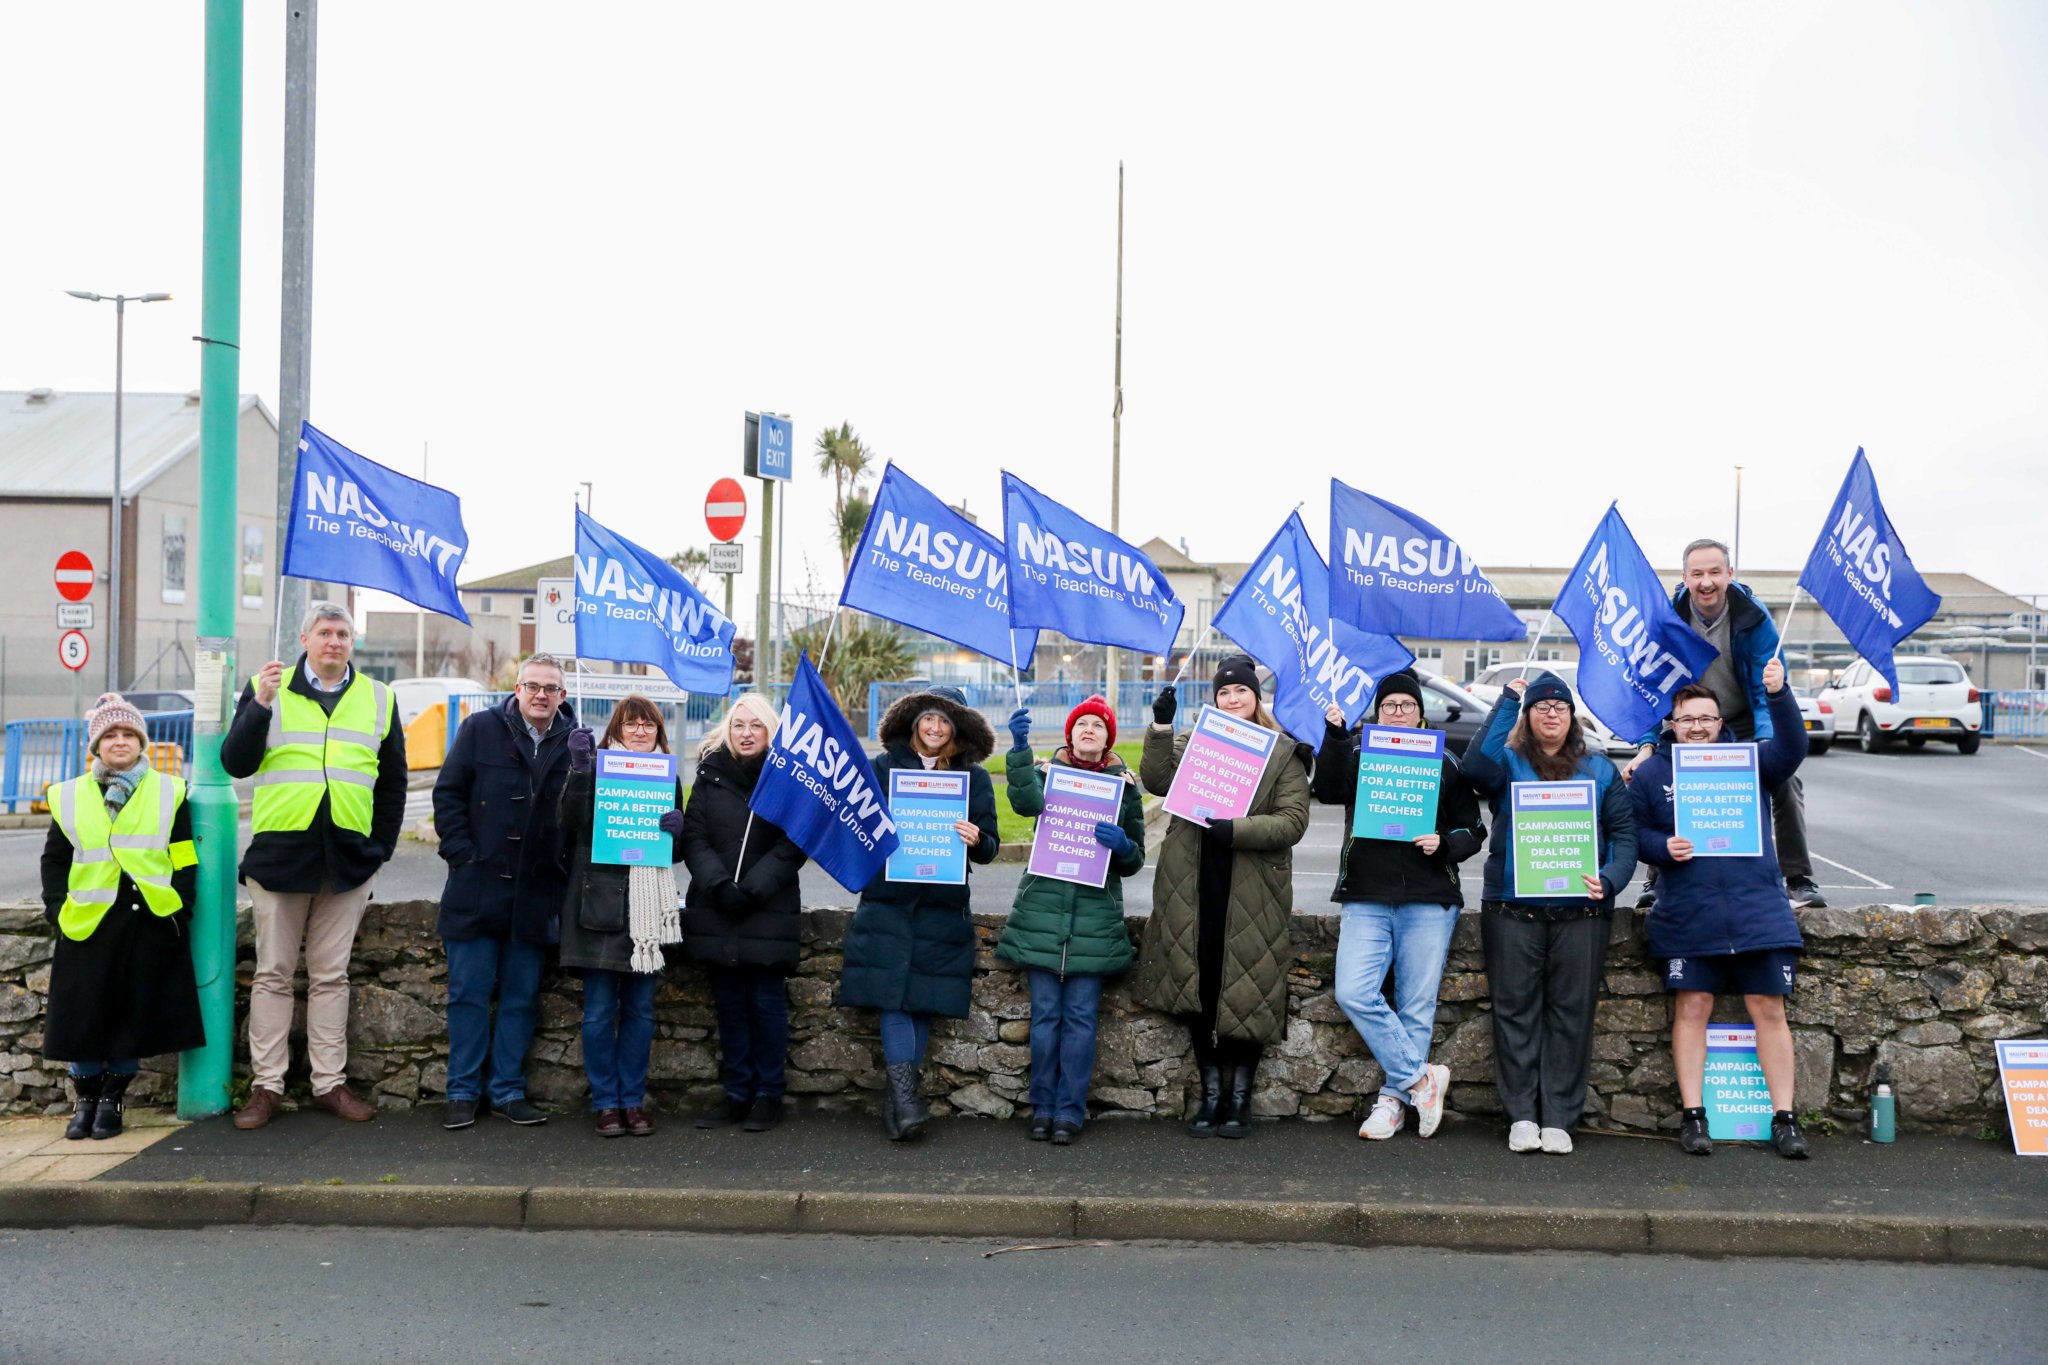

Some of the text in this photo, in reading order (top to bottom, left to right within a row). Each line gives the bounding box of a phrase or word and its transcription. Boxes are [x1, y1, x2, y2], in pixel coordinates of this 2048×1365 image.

[768, 428, 784, 446] NO
[766, 449, 786, 468] EXIT
[306, 514, 340, 534] The
[307, 471, 462, 578] NASWT
[713, 548, 739, 558] Except
[874, 510, 1008, 596] NASUW
[1344, 527, 1482, 578] NASUW
[1826, 536, 1842, 567] The
[714, 559, 737, 569] buses
[1018, 522, 1172, 606] NASUW
[871, 550, 981, 600] The Teachers'
[1344, 567, 1374, 586] The
[1379, 572, 1460, 593] Teachers'
[1021, 564, 1047, 585] The
[1053, 573, 1126, 601] Teachers'
[1588, 541, 1692, 694] NSUWT
[575, 598, 597, 614] he
[673, 636, 722, 657] Union
[1257, 553, 1374, 706] NASUWT
[1584, 574, 1599, 604] The
[1623, 668, 1660, 707] Union
[69, 642, 78, 658] 5
[1251, 585, 1277, 616] The
[1309, 686, 1332, 712] Uni
[583, 682, 607, 690] PLEASE
[644, 685, 681, 693] RECEPTION
[1192, 744, 1259, 775] CAMPAIGNING
[772, 703, 896, 841] NASUWT
[1188, 756, 1208, 769] FOR
[1218, 768, 1252, 787] BETTER
[1360, 762, 1439, 777] CAMPAIGNING
[1193, 772, 1238, 795] DEAL FOR
[1361, 776, 1435, 790] FOR A BETTER
[1679, 782, 1753, 791] CAMPAIGNING
[597, 787, 673, 800] CAMPAIGNING
[767, 748, 786, 769] he
[840, 806, 875, 852] Union
[1187, 783, 1234, 808] TEACHERS
[1370, 790, 1423, 802] DEAL FOR
[1681, 795, 1703, 804] FOR
[1714, 795, 1752, 804] BETTER
[598, 801, 670, 814] FOR A BETTER
[894, 808, 964, 819] CAMPAIGNING
[1045, 804, 1113, 823] CAMPAIGNING
[1368, 804, 1423, 816] TEACHERS
[1692, 808, 1742, 816] DEAL FOR
[608, 816, 659, 827] DEAL FOR
[895, 821, 956, 831] FOR A BETTE
[1044, 816, 1096, 833] FOR A BETT
[1518, 821, 1591, 830] CAMPAIGNING
[1690, 821, 1744, 829] TEACHERS
[606, 829, 660, 840] TEACHERS
[904, 834, 951, 844] DEAL FOR
[1051, 830, 1097, 846] DEAL FOR
[1520, 834, 1590, 843] FOR A BETTER
[903, 847, 952, 857] TEACHERS
[1048, 842, 1096, 859] TEACHERS
[1531, 848, 1581, 856] DEAL FOR
[1529, 861, 1582, 869] TEACHERS
[1704, 1062, 1761, 1071] CAMPAIGN
[1705, 1076, 1766, 1086] FOR A BETT
[1716, 1090, 1771, 1099] DEAL FOR
[2013, 1093, 2046, 1102] FOR A
[1715, 1104, 1774, 1113] TEACHERS
[2026, 1106, 2048, 1114] DEA
